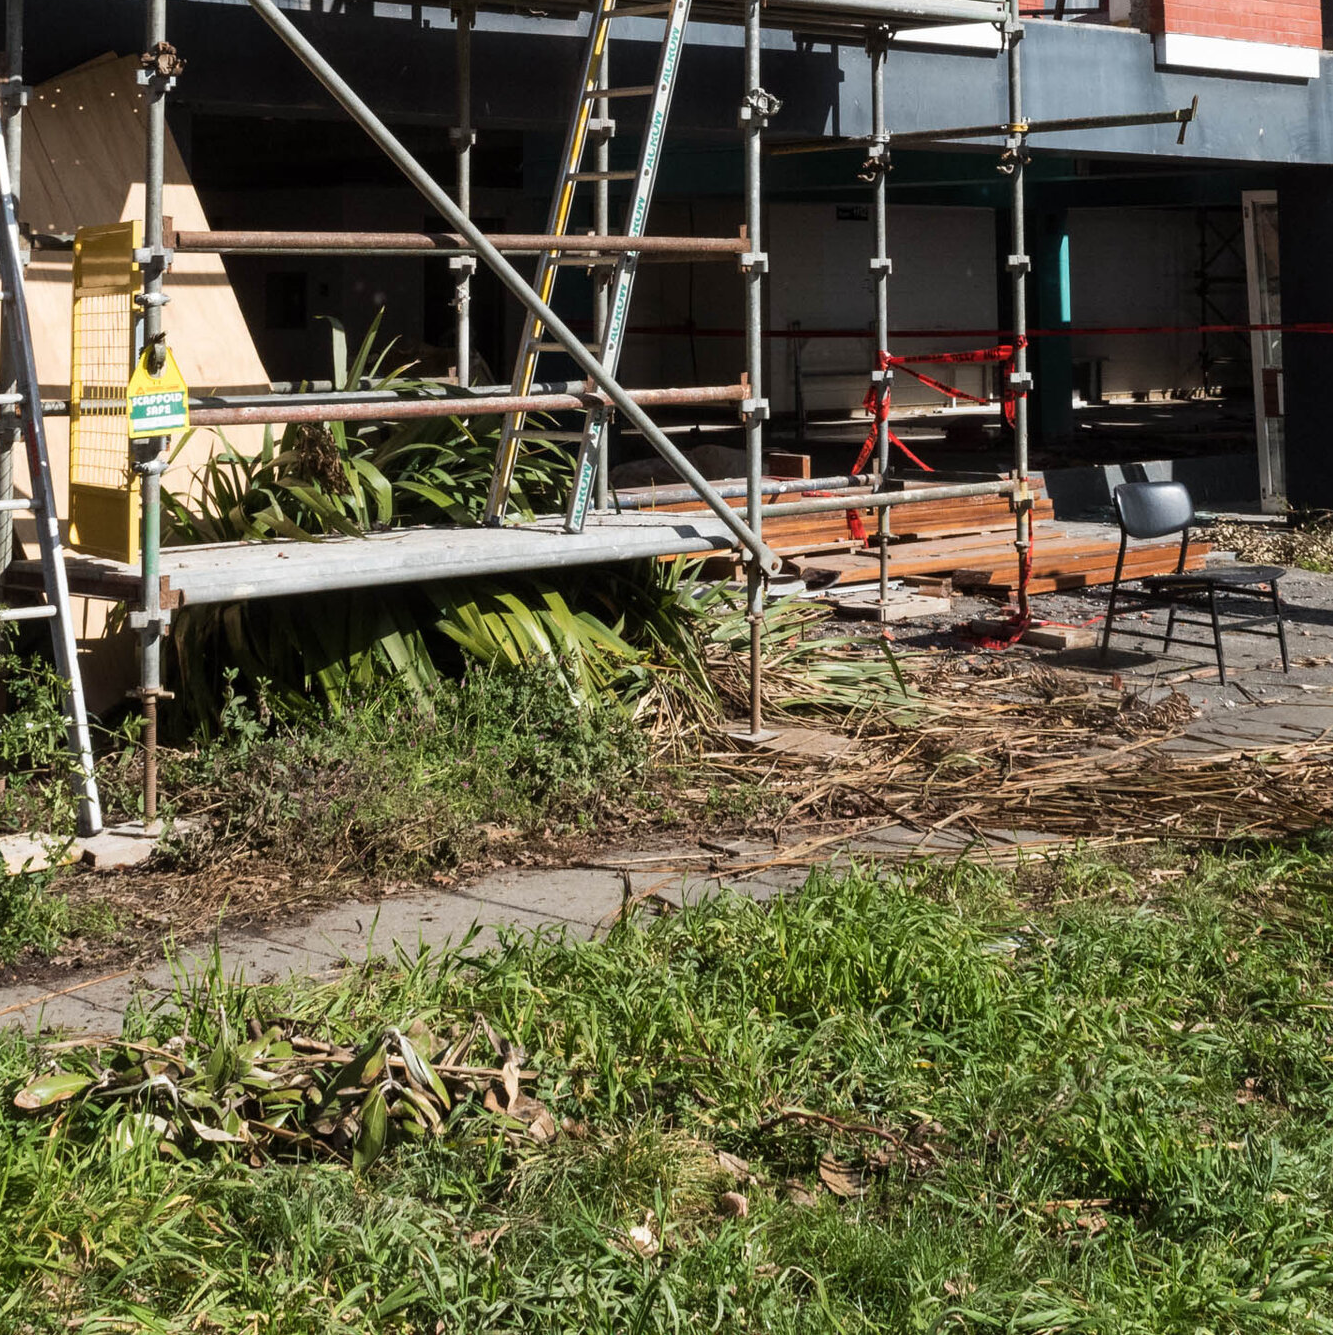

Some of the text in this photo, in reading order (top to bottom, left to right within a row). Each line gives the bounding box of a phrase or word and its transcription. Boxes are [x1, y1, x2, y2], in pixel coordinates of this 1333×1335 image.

[663, 27, 680, 84] ACROW
[646, 111, 663, 169] ACROW
[610, 284, 627, 343] ACROW
[132, 392, 183, 407] SCAFFOLD
[146, 404, 172, 417] SAFE
